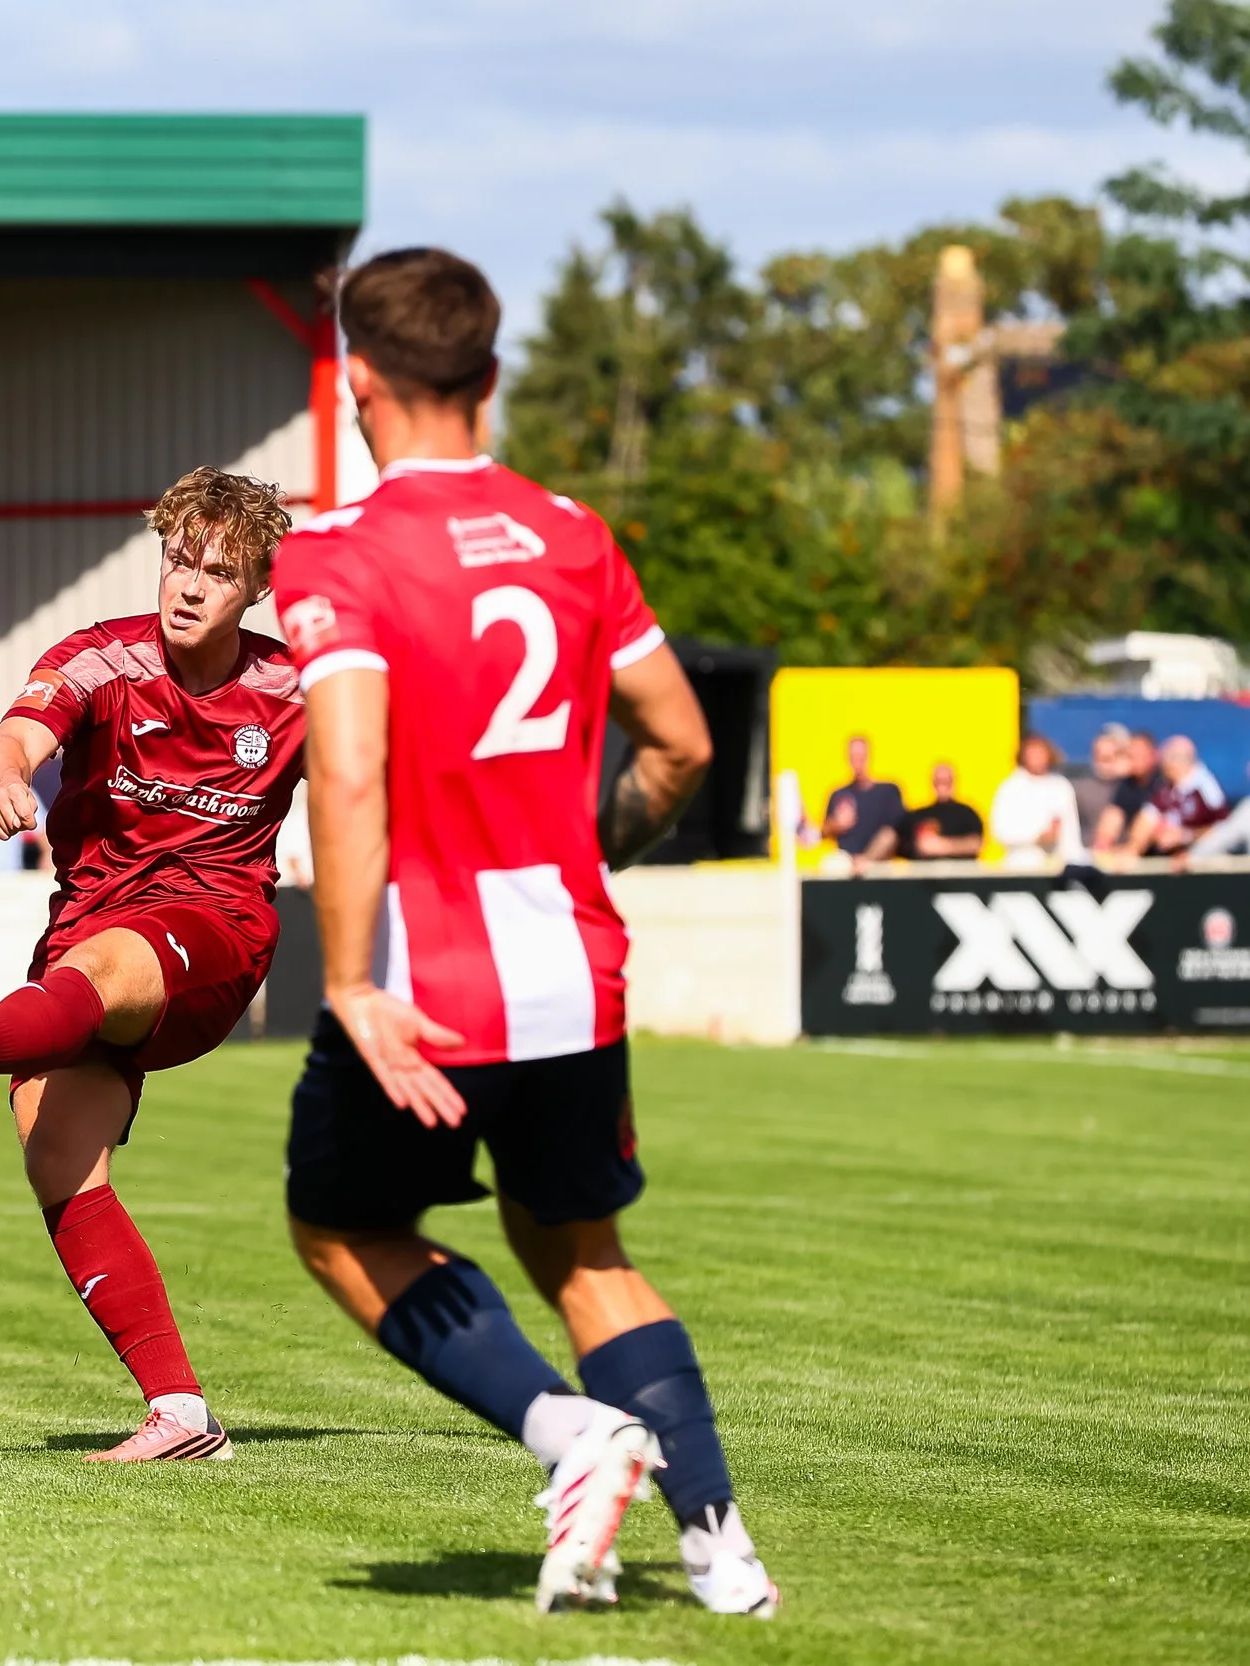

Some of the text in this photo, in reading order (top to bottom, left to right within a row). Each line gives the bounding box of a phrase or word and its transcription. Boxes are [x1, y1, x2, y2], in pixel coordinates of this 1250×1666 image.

[471, 584, 571, 760] 2
[107, 765, 265, 818] Simply athroom
